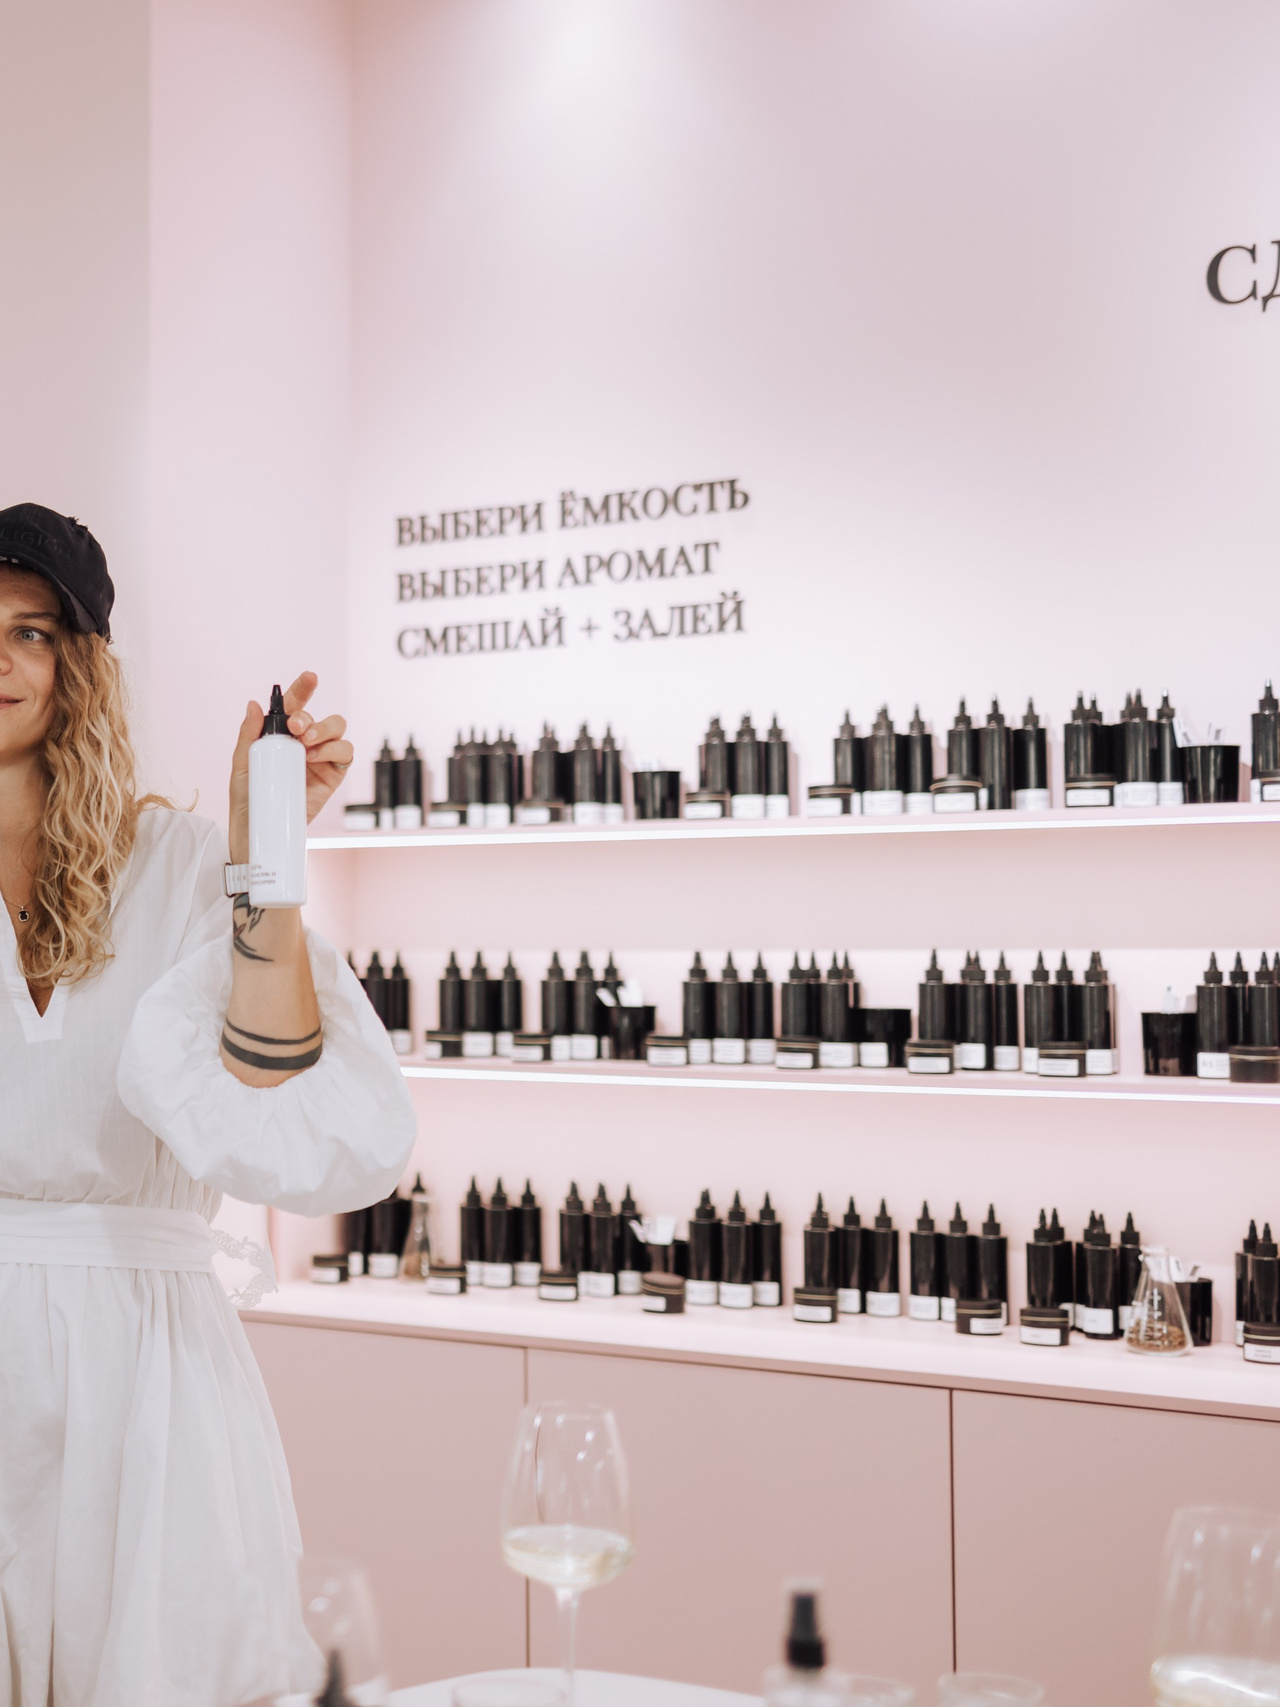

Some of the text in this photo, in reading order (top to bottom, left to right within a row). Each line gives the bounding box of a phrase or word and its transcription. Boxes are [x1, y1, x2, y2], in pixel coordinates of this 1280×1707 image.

[395, 478, 750, 547] ВЫБЕРИ ЁМКОСТЬ
[395, 541, 720, 603] ВЫБЕРИ АРОМАТ
[396, 590, 745, 659] СМЕШАЙ + ЗАЛЕЙ
